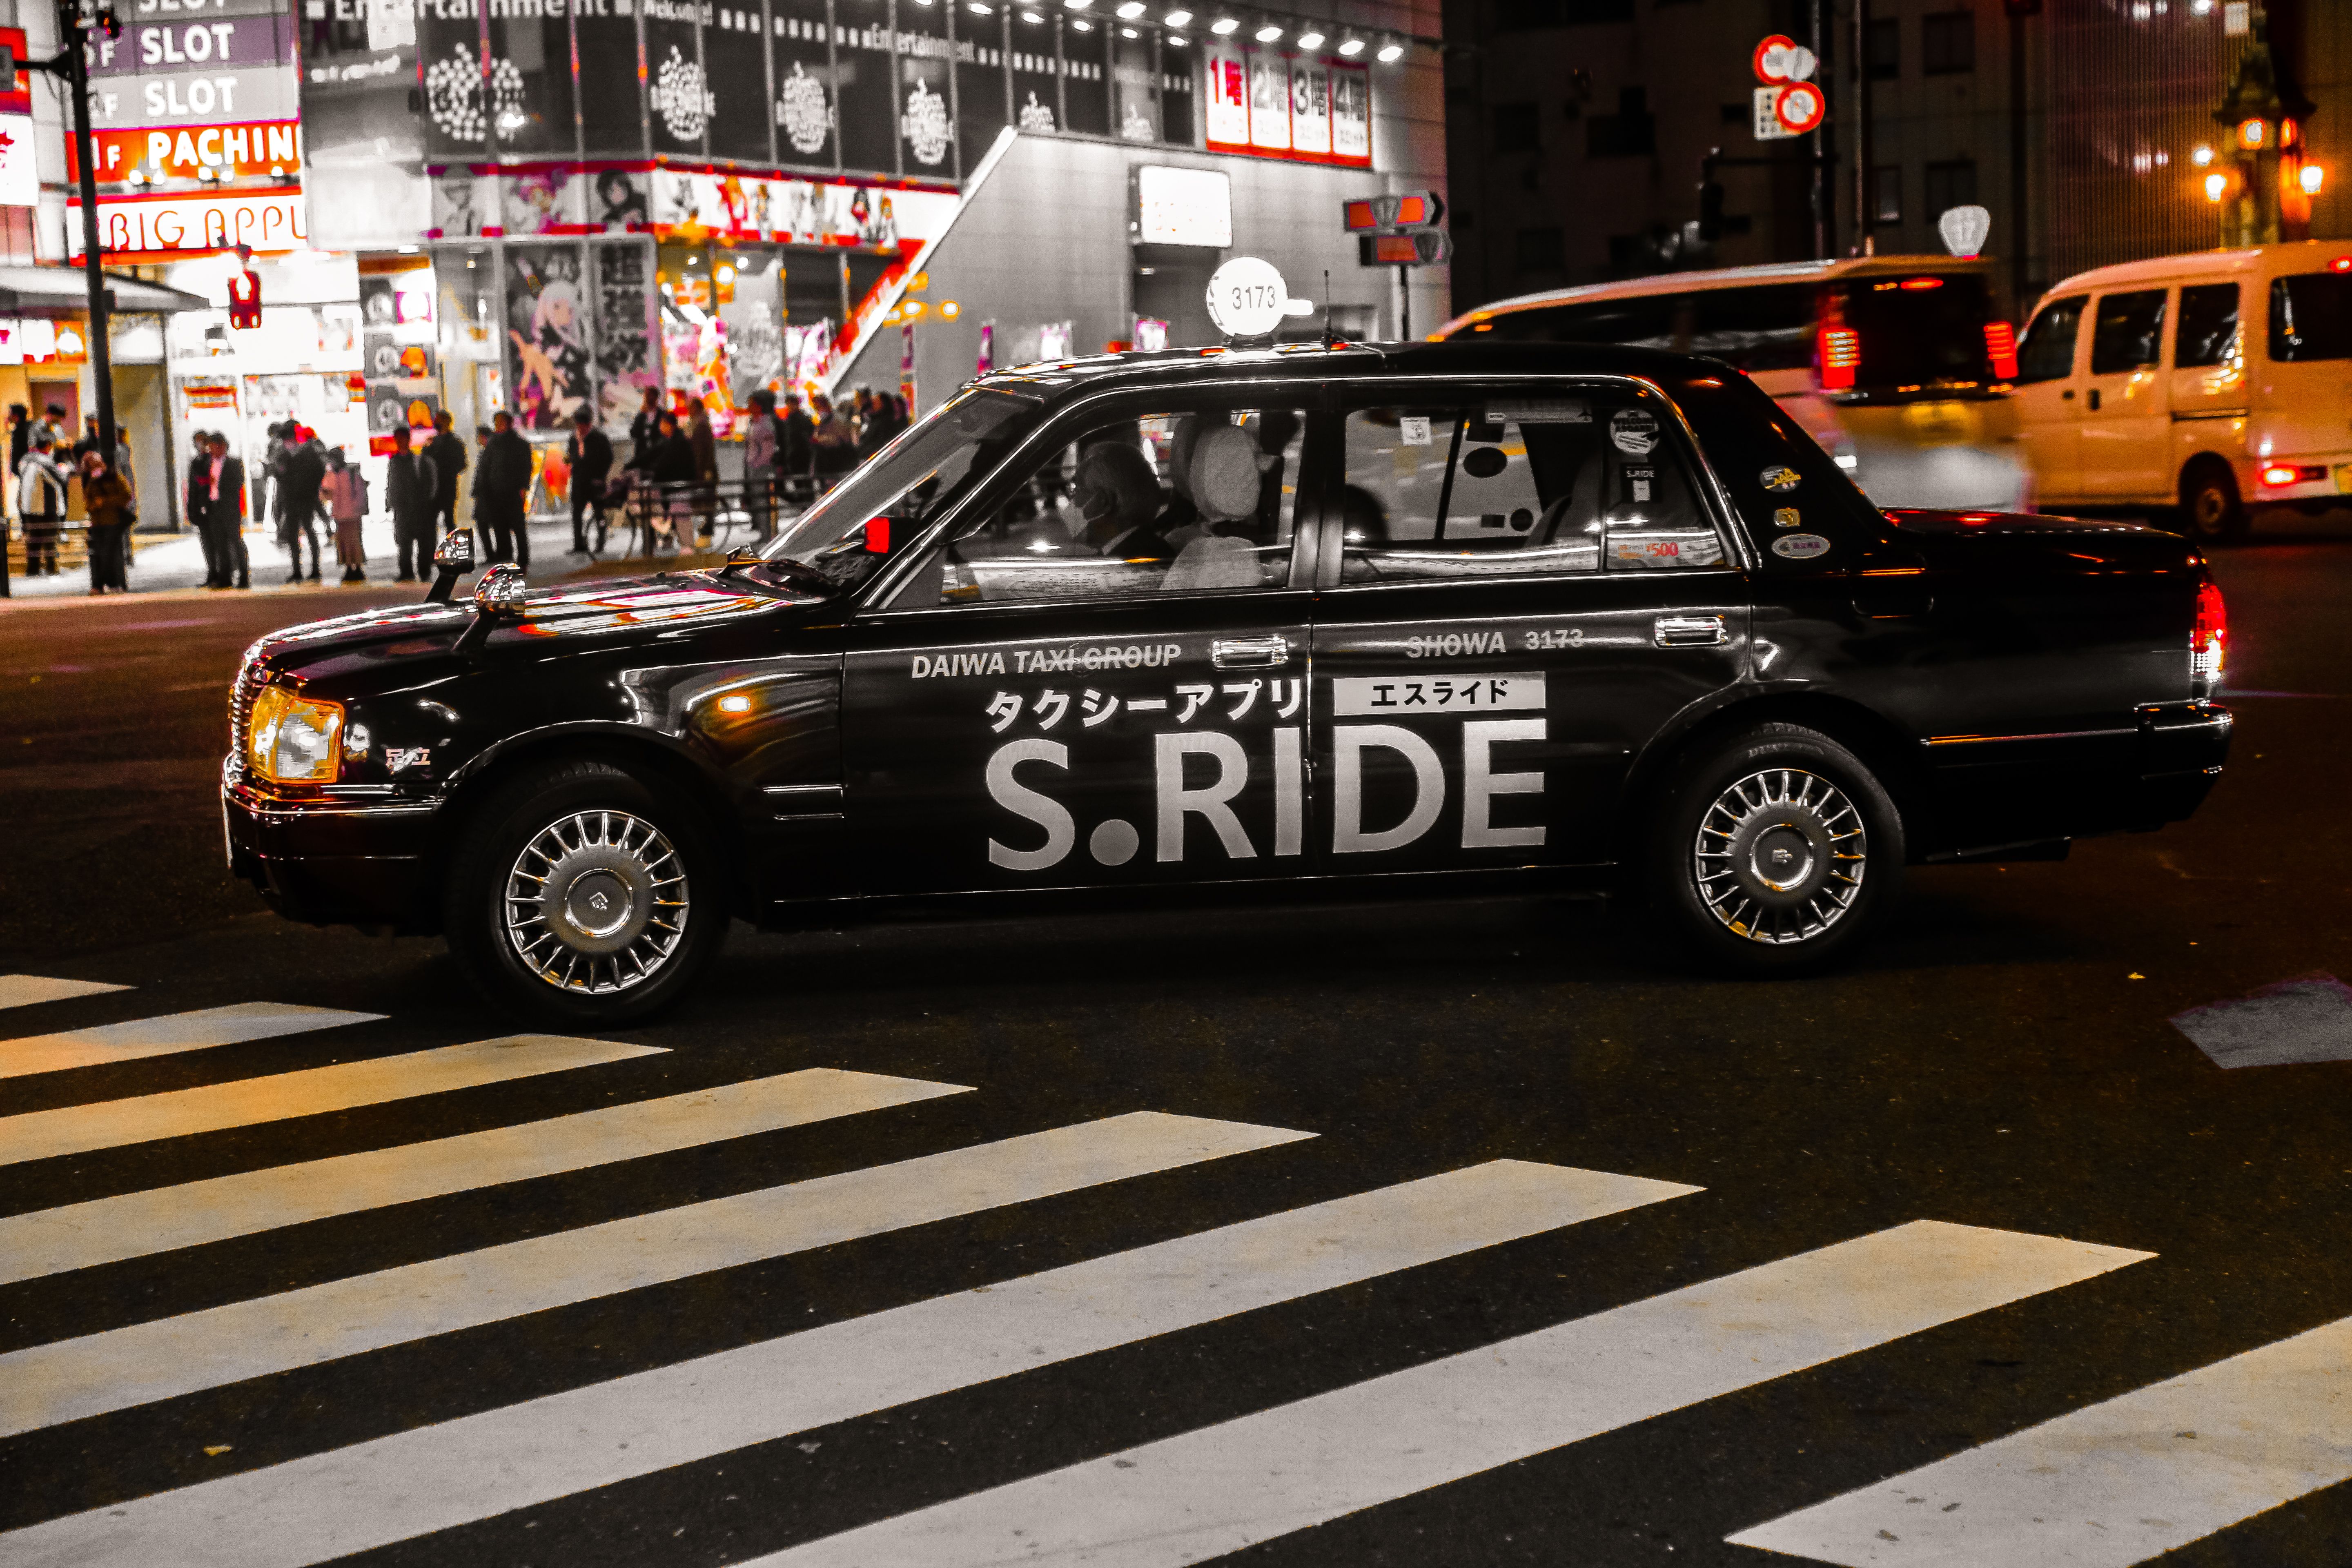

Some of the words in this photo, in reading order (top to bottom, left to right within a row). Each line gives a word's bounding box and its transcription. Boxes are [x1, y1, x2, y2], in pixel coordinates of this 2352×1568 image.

[335, 0, 609, 20] Enrtainment
[141, 23, 235, 65] SLOT
[145, 77, 238, 118] SLOT
[148, 125, 301, 169] PACHIN
[109, 210, 185, 249] BIG
[1232, 285, 1275, 310] 3173
[911, 652, 1006, 679] DAIWA
[1014, 648, 1075, 674] TAXI
[1082, 644, 1182, 670] GROUP
[1406, 632, 1506, 658] SHOWA
[1525, 628, 1584, 650] 3173
[985, 678, 1301, 733] タクシーアプリ
[1370, 679, 1509, 707] エスライド
[985, 719, 1547, 871] S.RIDE
